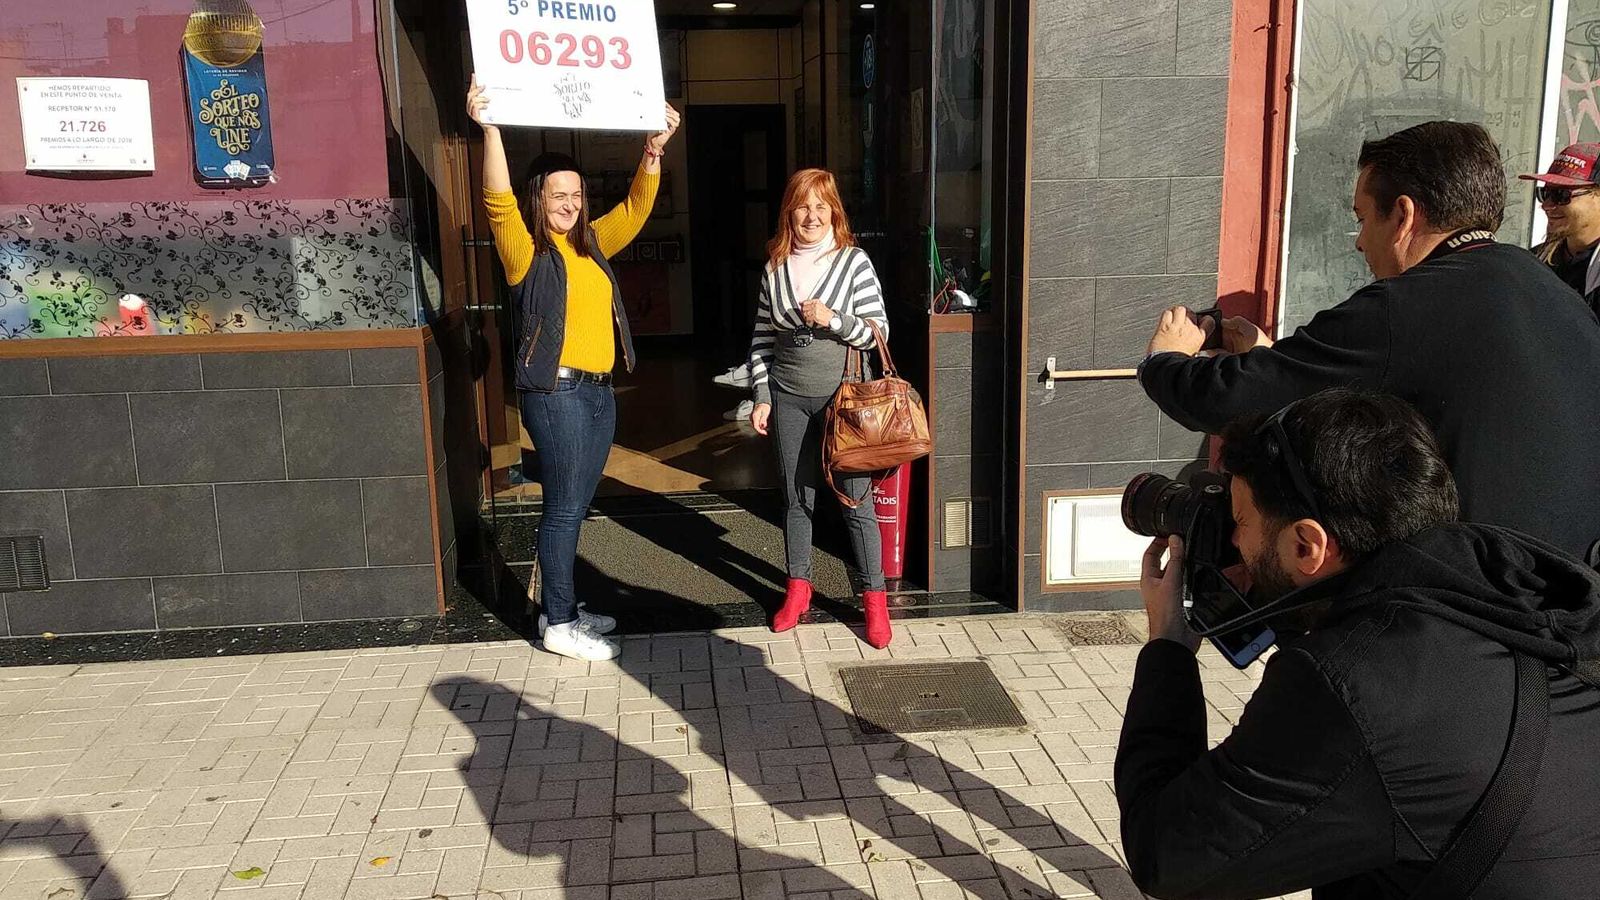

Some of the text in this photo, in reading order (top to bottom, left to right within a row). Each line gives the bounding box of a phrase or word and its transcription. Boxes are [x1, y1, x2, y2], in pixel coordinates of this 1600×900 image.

[538, 0, 617, 22] PREMIO
[499, 29, 632, 70] 06293
[199, 93, 260, 124] SORTEO
[214, 110, 261, 129] QUE NOS
[59, 120, 107, 132] 21.726
[209, 127, 251, 155] UNE
